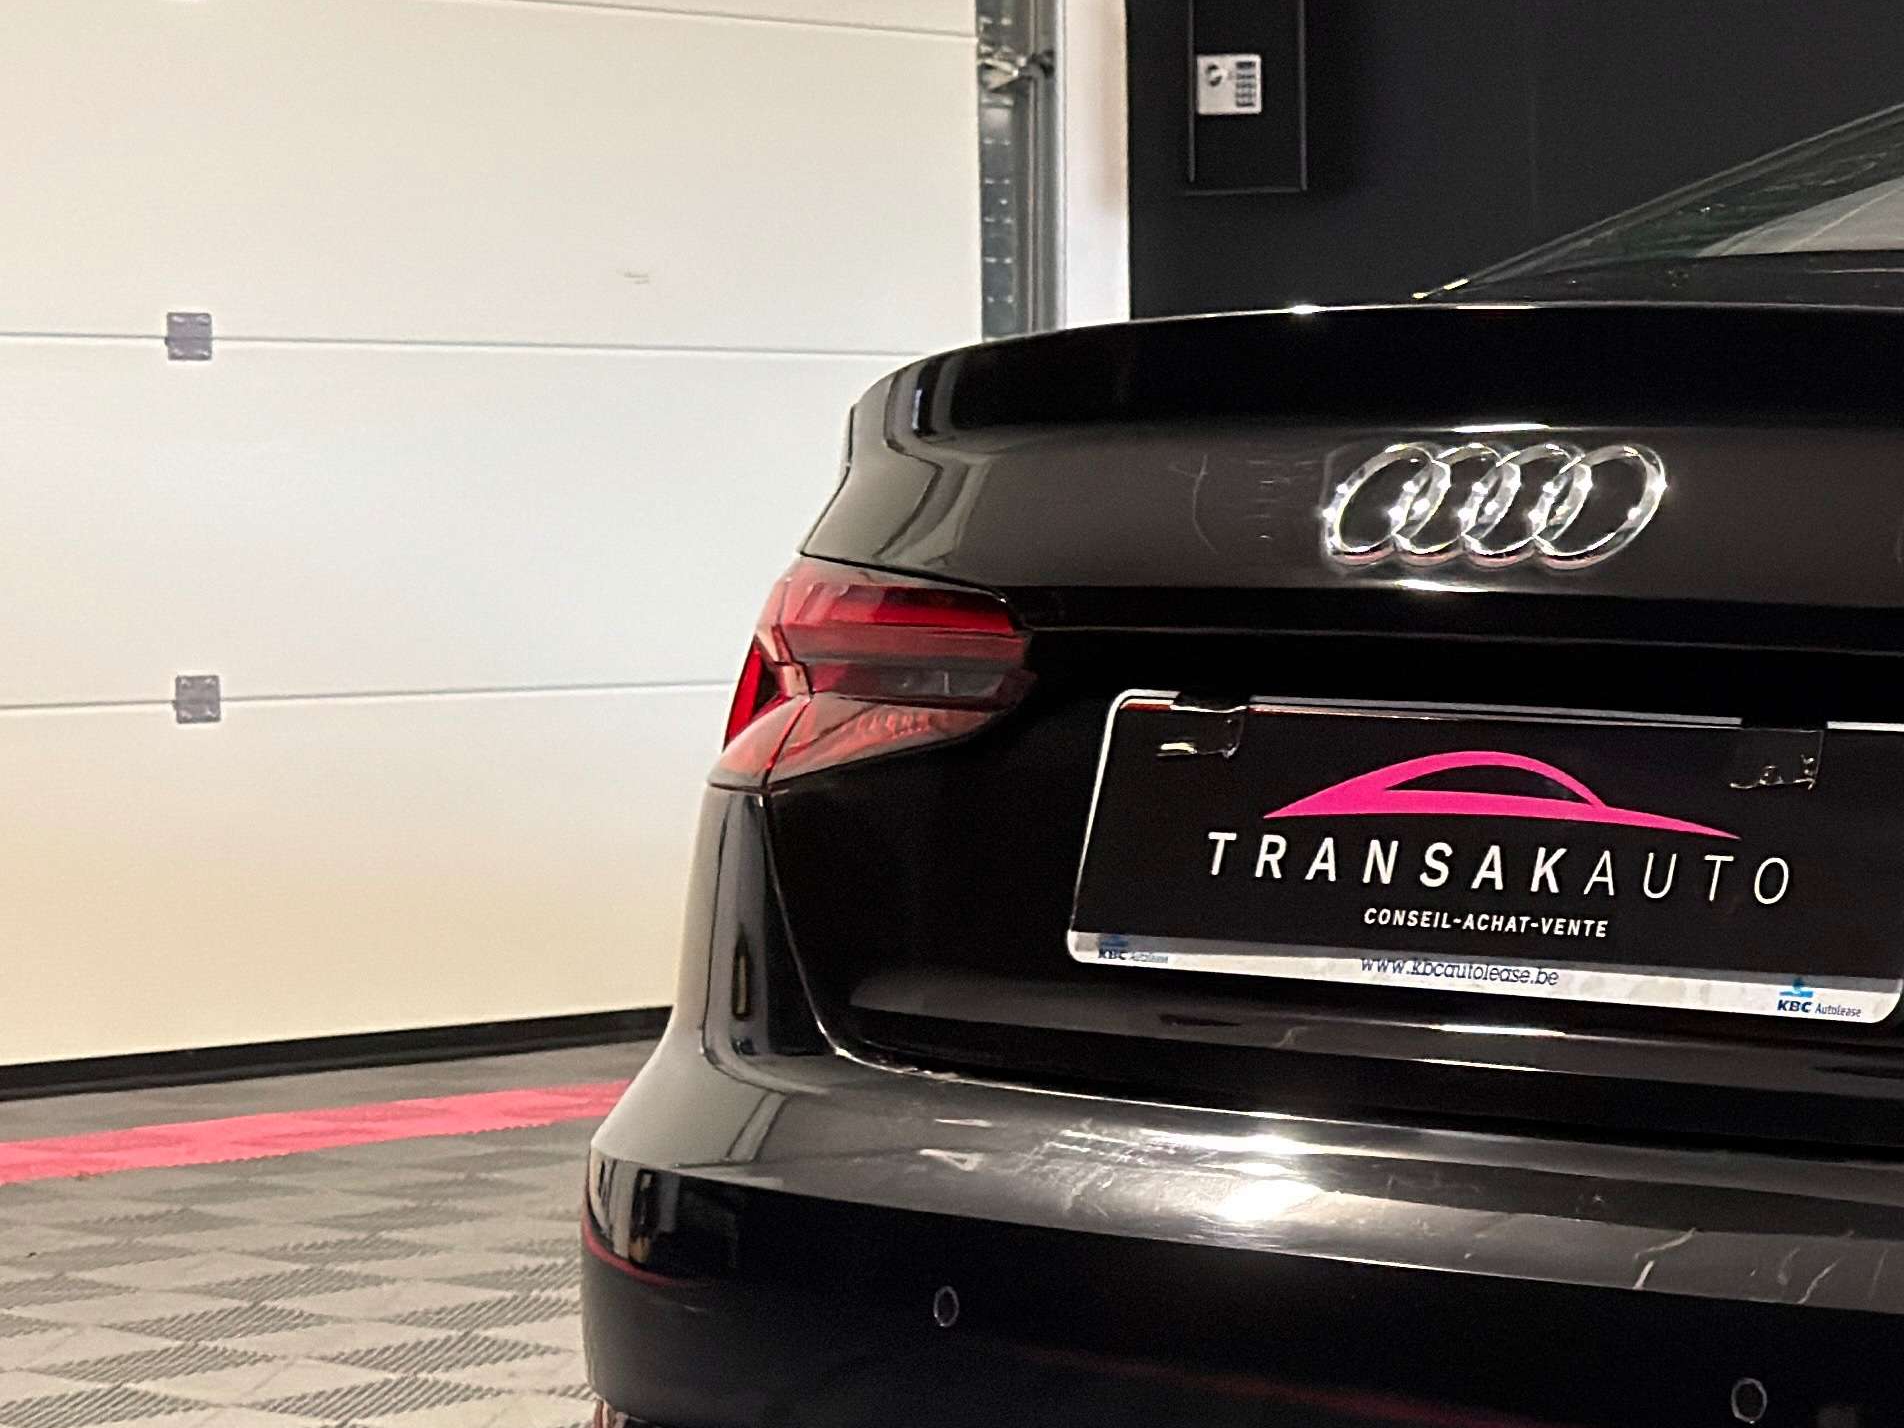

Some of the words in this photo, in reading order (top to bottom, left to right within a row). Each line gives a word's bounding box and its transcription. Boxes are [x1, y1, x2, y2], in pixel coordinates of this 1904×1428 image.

[1207, 831, 1790, 905] TRANSAKAUTO
[1363, 907, 1609, 938] CONSEIL-ACHAT-VENTE
[1360, 956, 1560, 986] www.kbcautolease.be
[1777, 999, 1812, 1013] KBC
[1815, 1003, 1862, 1018] Autolease
